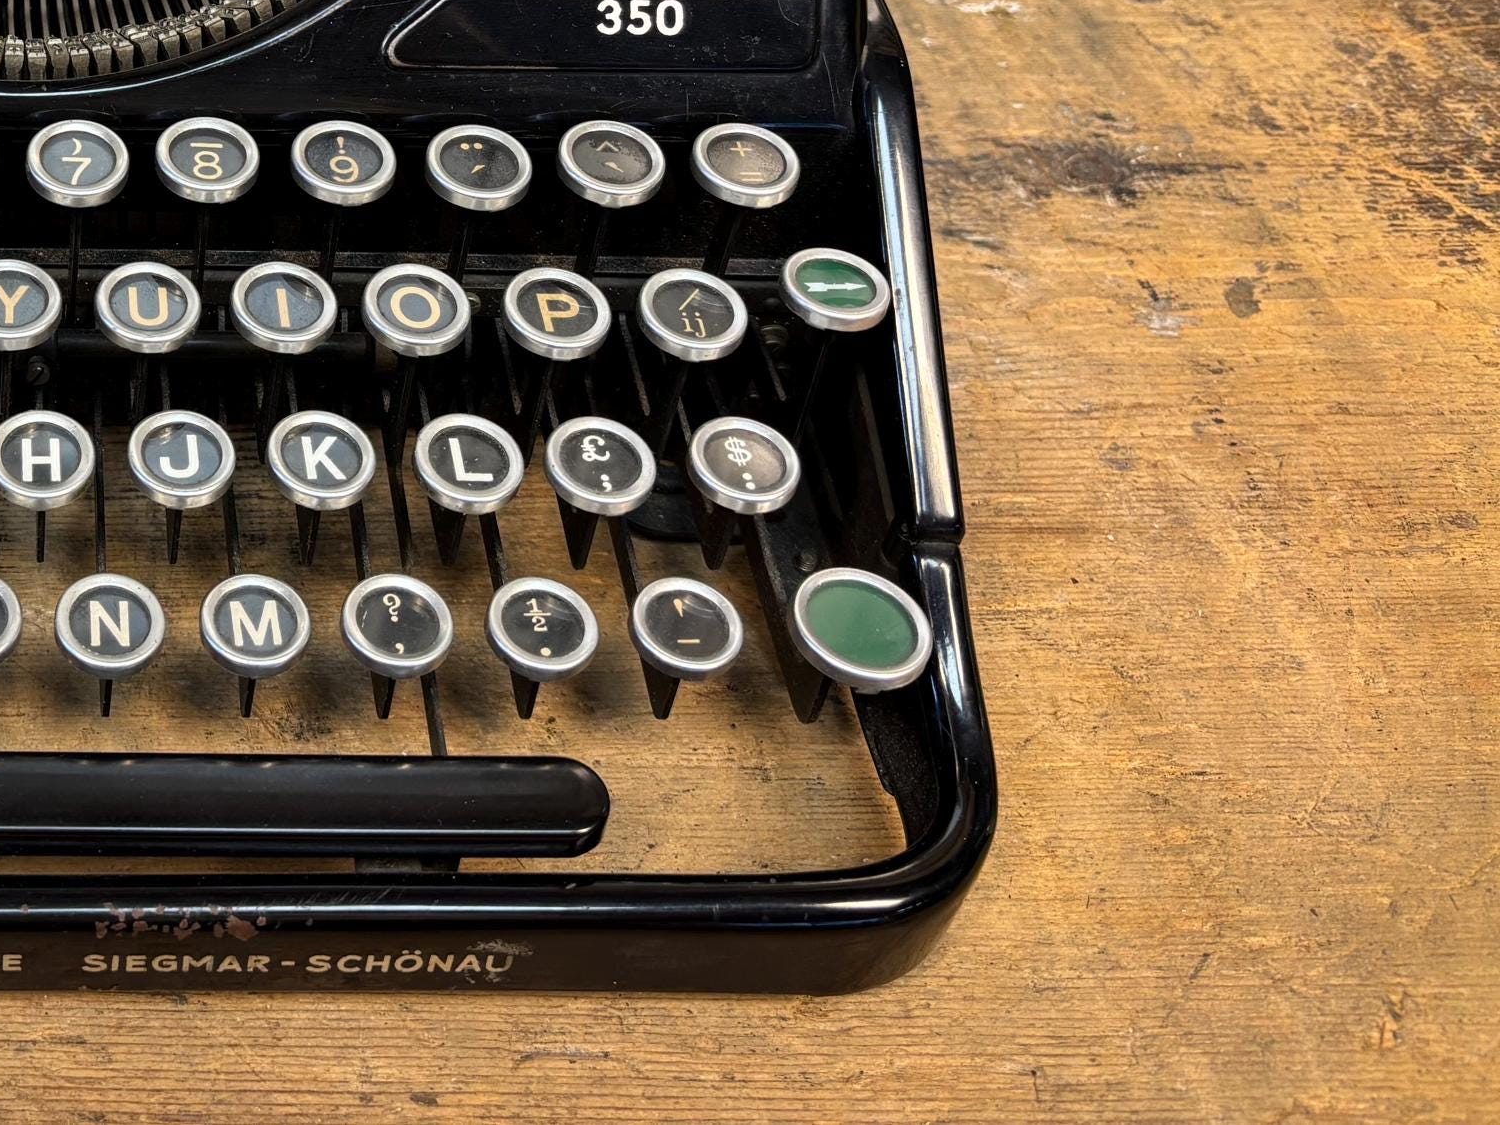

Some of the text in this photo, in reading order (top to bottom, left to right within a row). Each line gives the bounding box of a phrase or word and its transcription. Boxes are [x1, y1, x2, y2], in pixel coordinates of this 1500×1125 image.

[597, 0, 684, 37] 350
[62, 157, 91, 185] 7
[193, 151, 222, 179] 8
[330, 156, 359, 182] 9
[129, 287, 168, 326] U
[276, 289, 290, 327] I
[391, 287, 440, 328] O
[537, 293, 579, 333] P
[22, 437, 61, 481] H
[160, 435, 199, 478] J
[301, 436, 347, 479] K
[449, 438, 493, 481] L
[725, 437, 752, 466] $
[90, 601, 130, 646] N
[230, 600, 282, 646] M
[383, 594, 401, 622] ?
